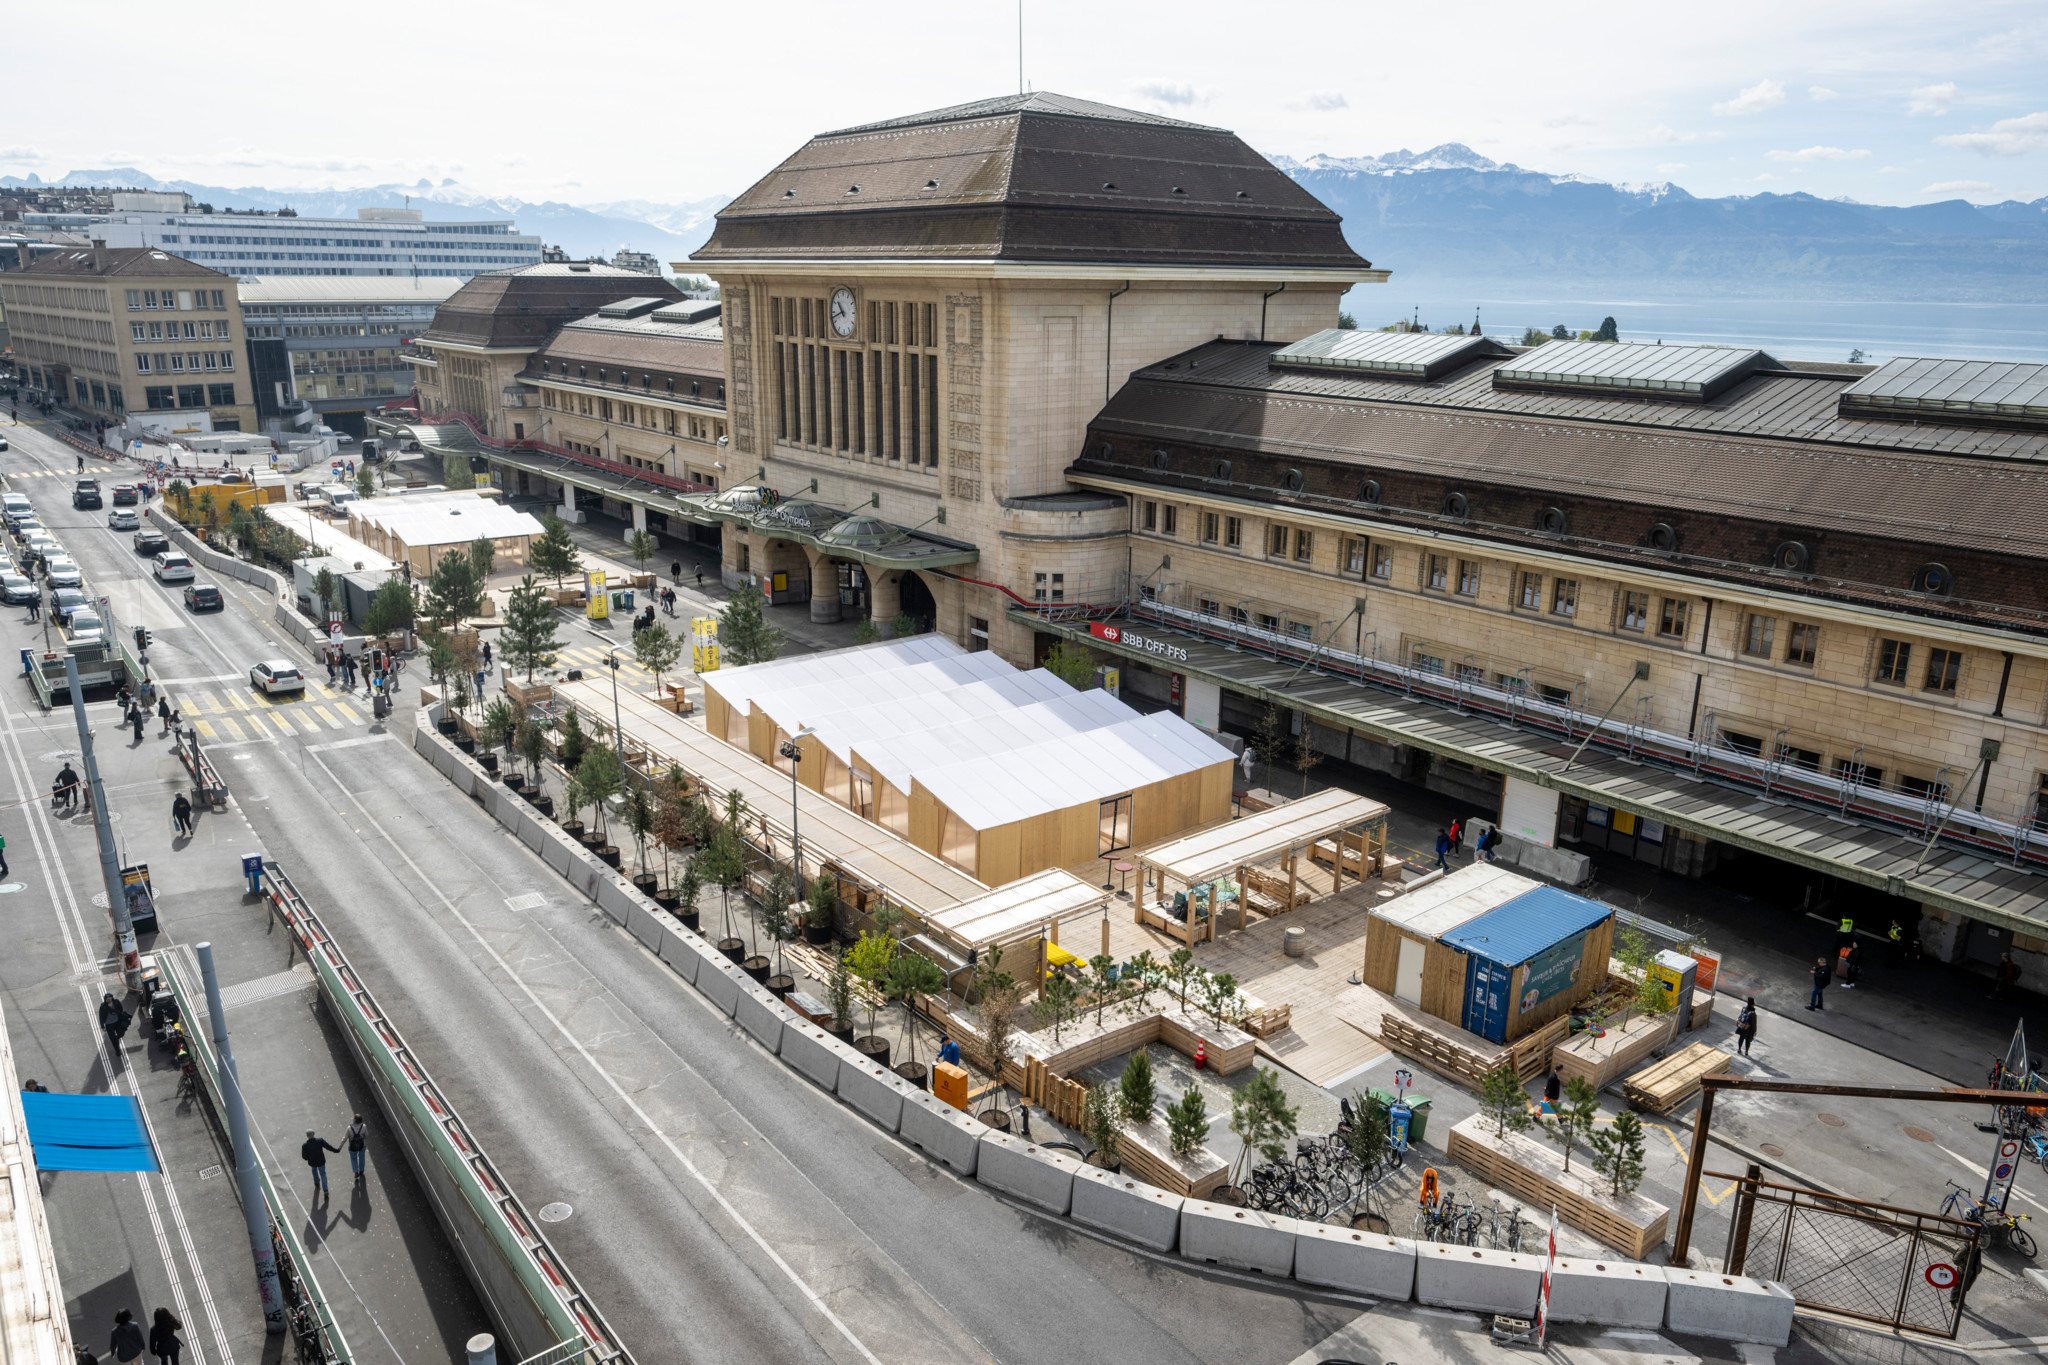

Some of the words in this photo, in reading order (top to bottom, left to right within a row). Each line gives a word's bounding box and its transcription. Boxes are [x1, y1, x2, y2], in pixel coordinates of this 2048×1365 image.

[732, 498, 756, 512] Lausanne
[757, 505, 779, 518] Capitale
[780, 511, 811, 527] Olympique
[595, 576, 603, 613] ENTRACTE
[706, 624, 714, 665] ENTRACTE
[1122, 632, 1143, 648] SBB
[1146, 639, 1165, 654] CFF
[1168, 645, 1187, 661] FFS
